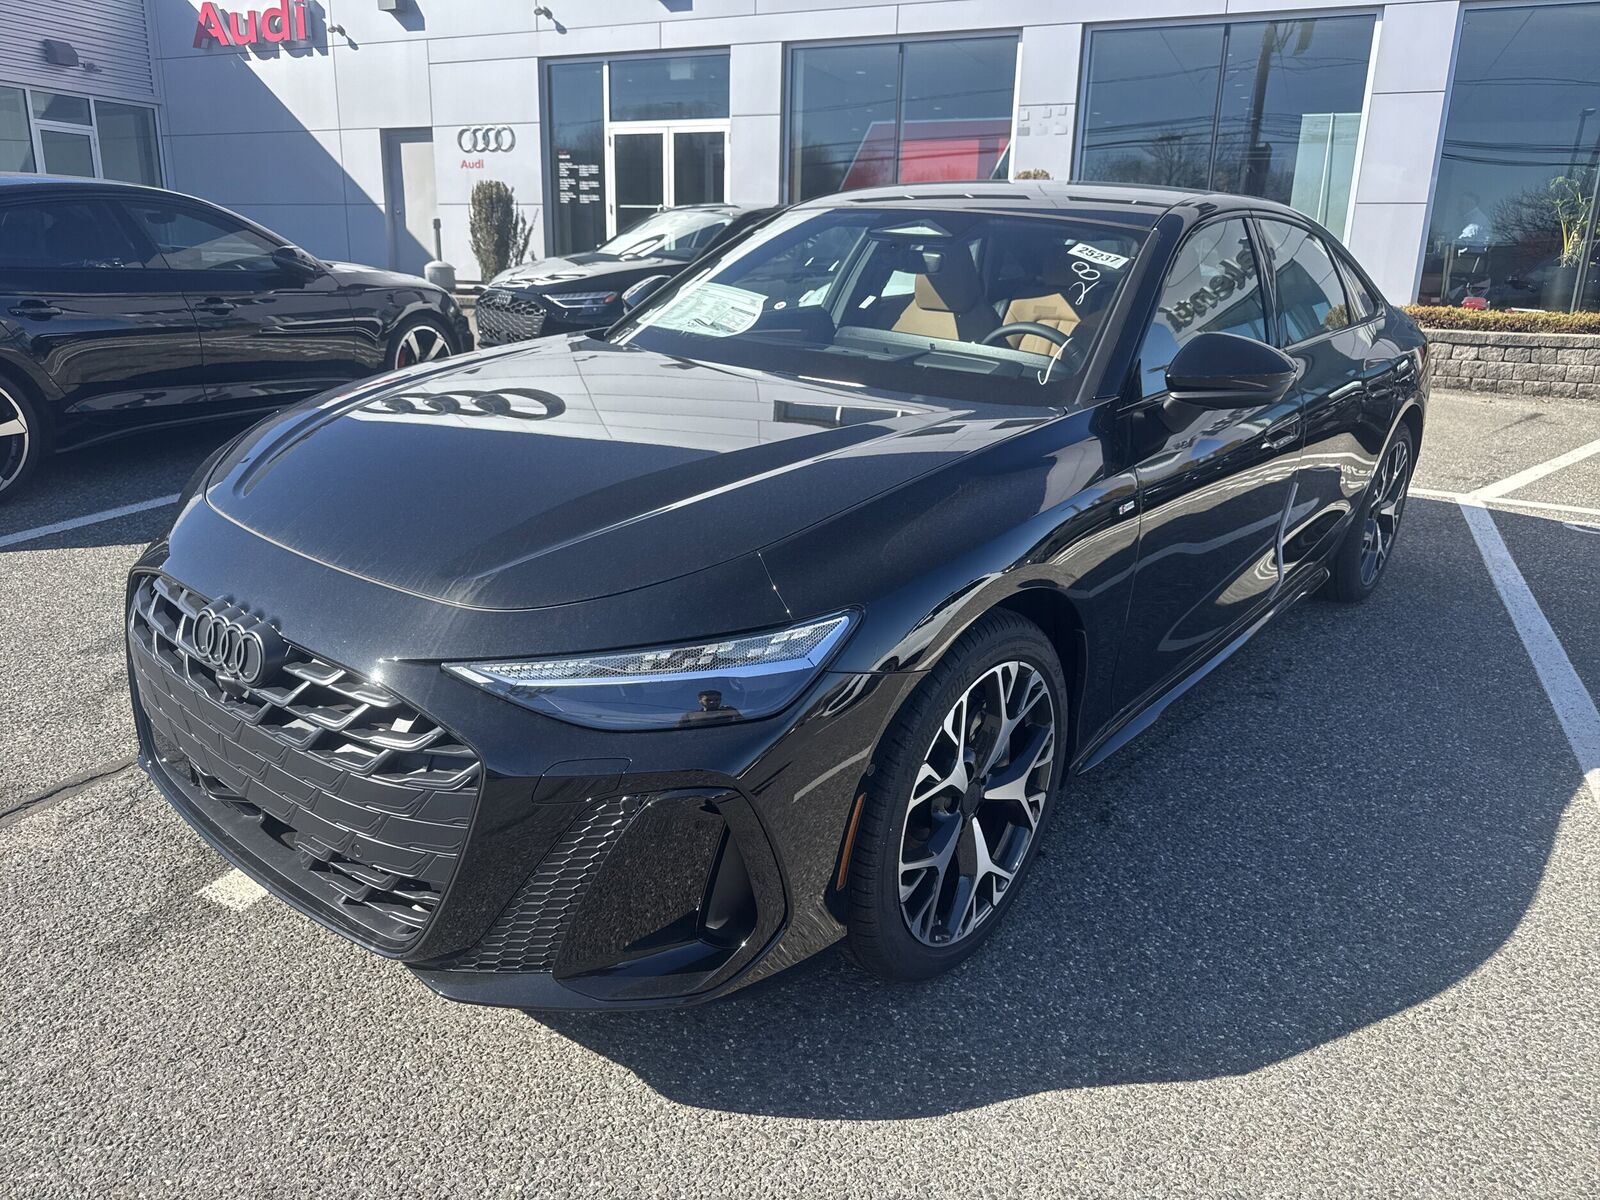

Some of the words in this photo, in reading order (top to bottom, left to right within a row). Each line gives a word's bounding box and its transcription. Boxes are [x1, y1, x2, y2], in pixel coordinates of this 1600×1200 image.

[193, 0, 306, 48] Audi
[461, 159, 484, 169] Audi
[1077, 246, 1121, 263] 25237
